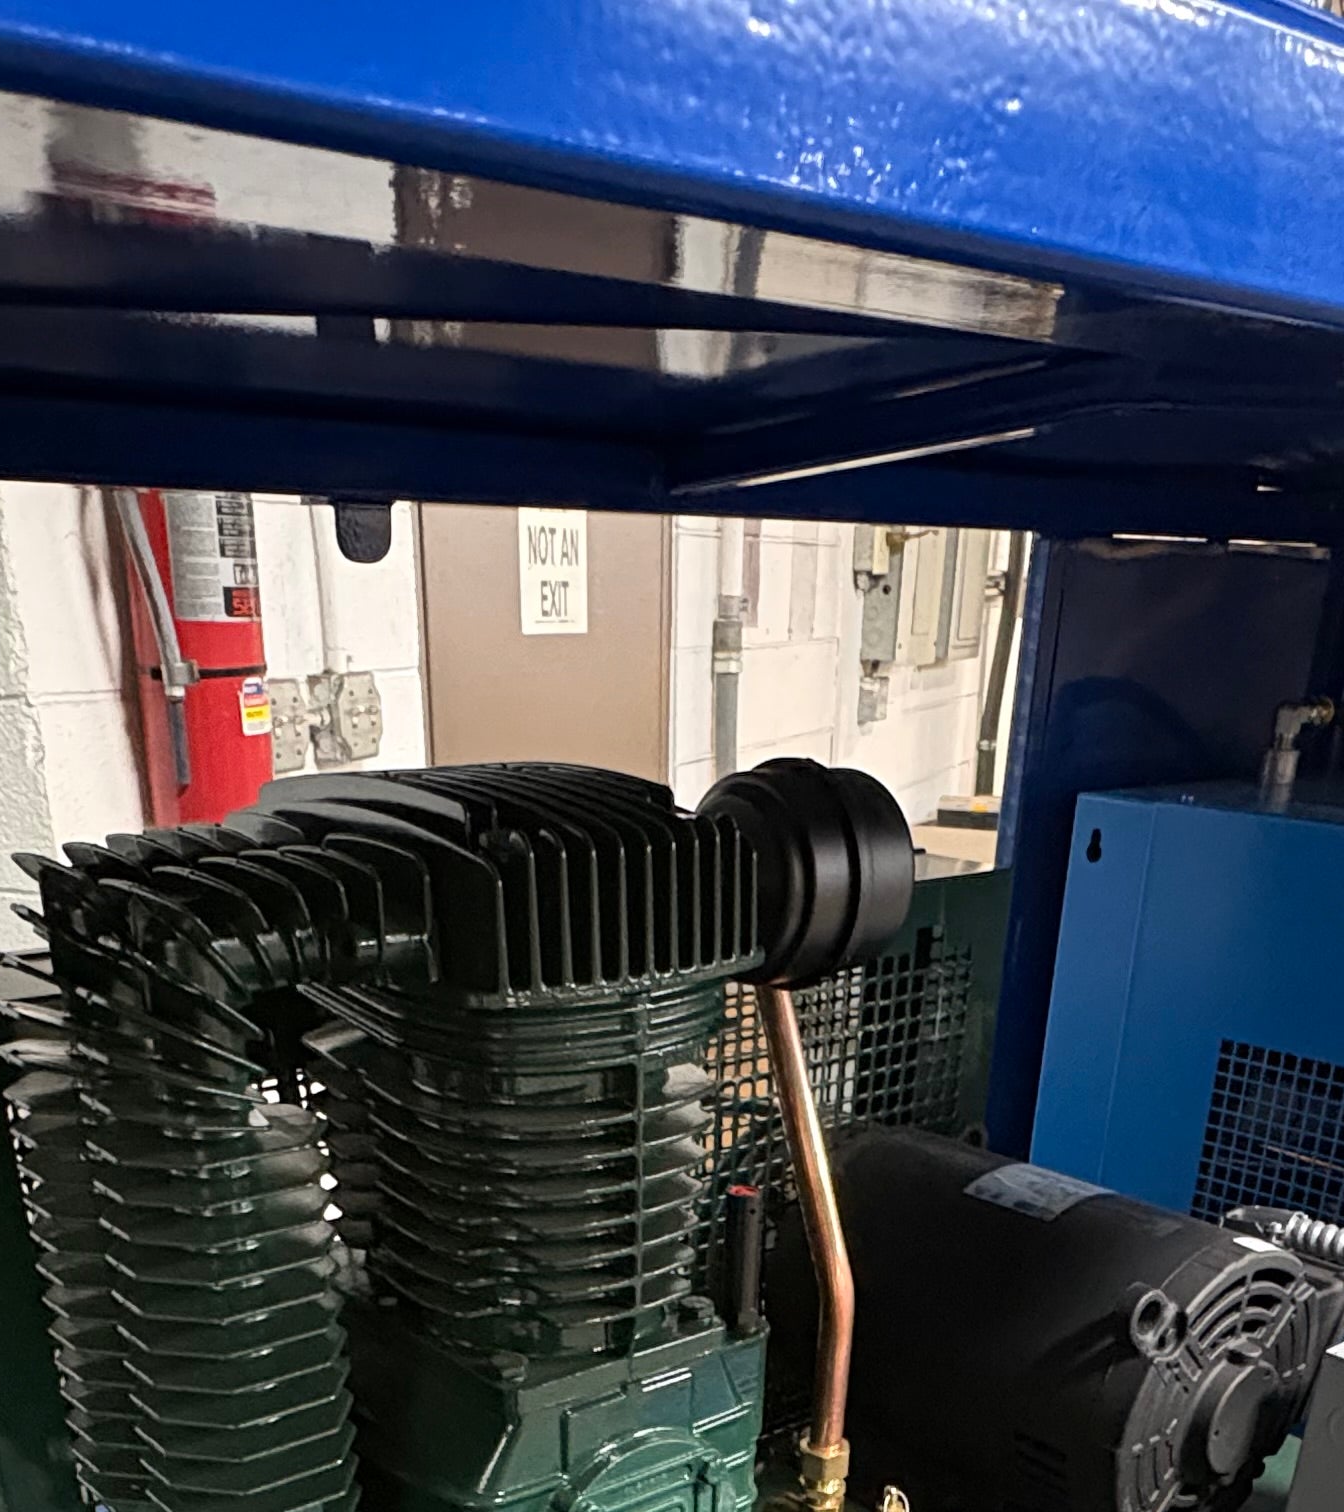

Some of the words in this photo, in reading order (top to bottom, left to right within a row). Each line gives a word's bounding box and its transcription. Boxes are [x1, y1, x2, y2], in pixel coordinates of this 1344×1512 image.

[528, 525, 556, 565] NOT
[560, 528, 579, 566] AN
[540, 580, 569, 617] EXIT
